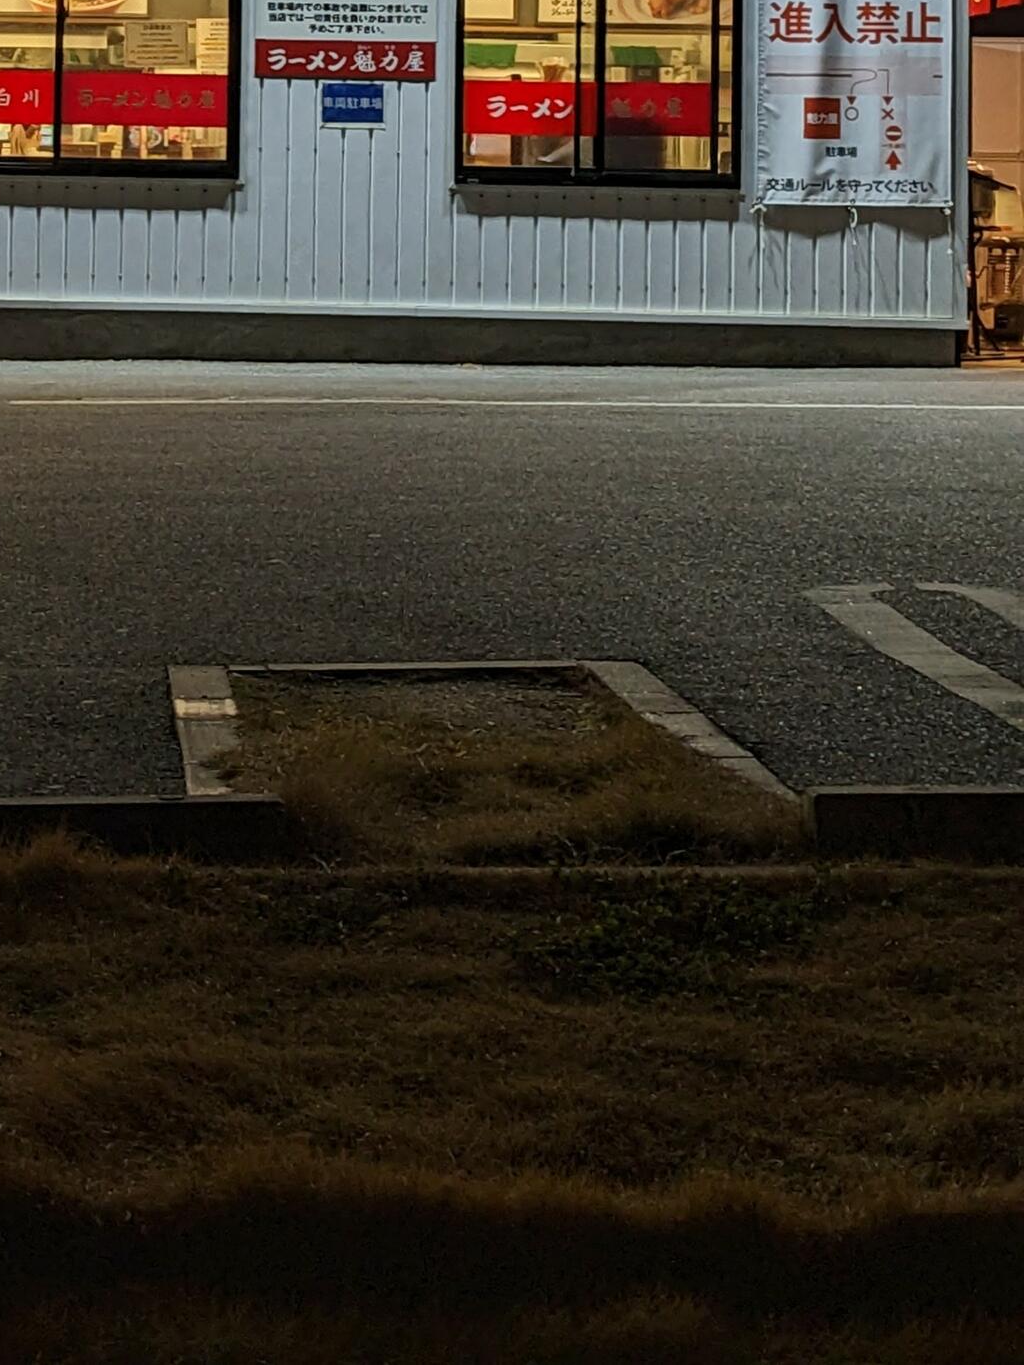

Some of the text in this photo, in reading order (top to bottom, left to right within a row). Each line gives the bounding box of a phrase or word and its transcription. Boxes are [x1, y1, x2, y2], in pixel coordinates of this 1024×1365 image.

[768, 0, 944, 45] 進入禁止
[266, 47, 426, 73] ラーメン魁力屋
